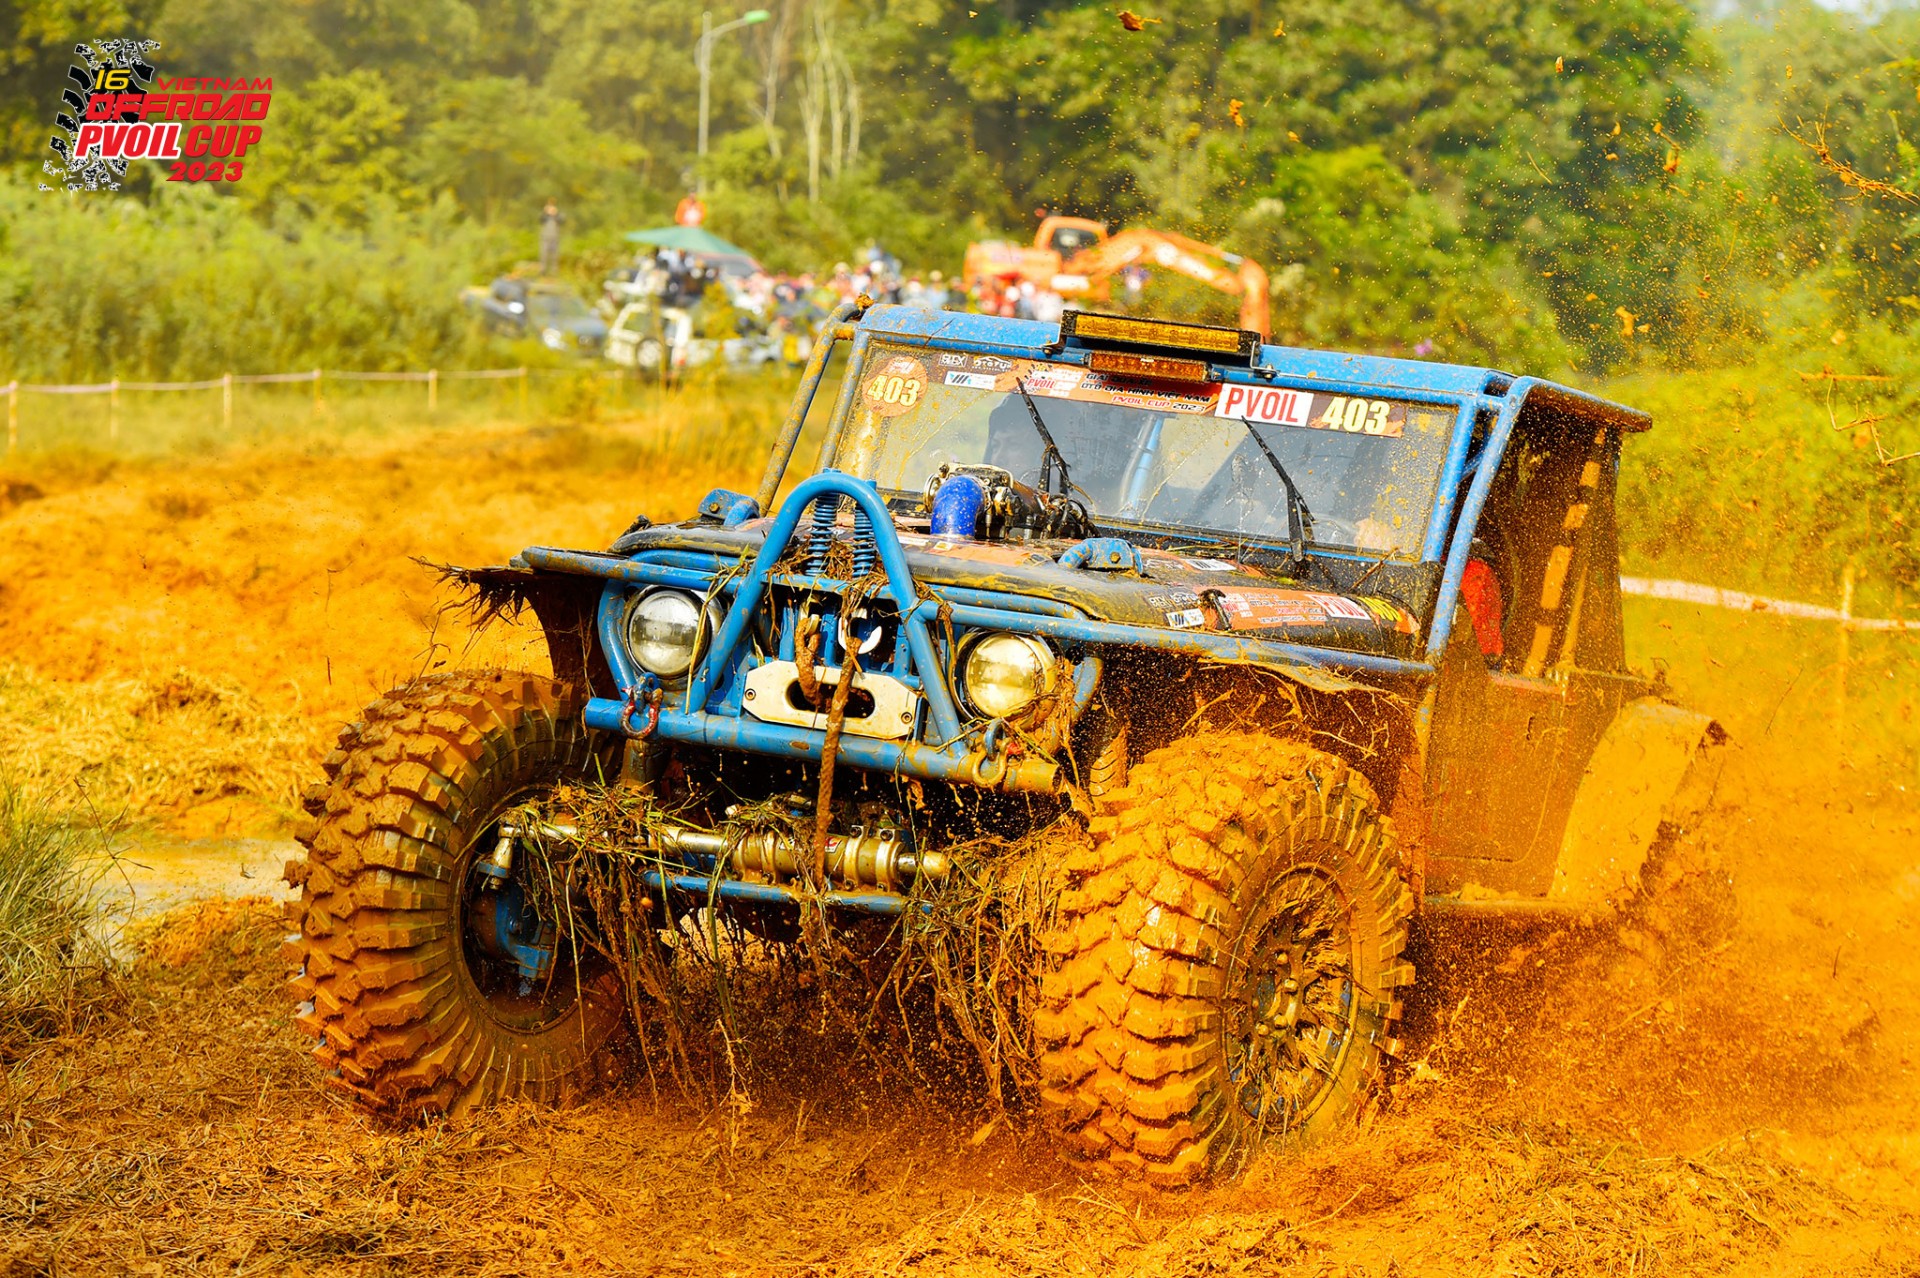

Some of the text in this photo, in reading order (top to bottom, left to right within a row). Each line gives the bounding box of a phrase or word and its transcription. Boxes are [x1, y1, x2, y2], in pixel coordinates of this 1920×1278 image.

[867, 374, 921, 406] 403
[1224, 386, 1299, 423] PVOIL
[1320, 397, 1390, 435] 403
